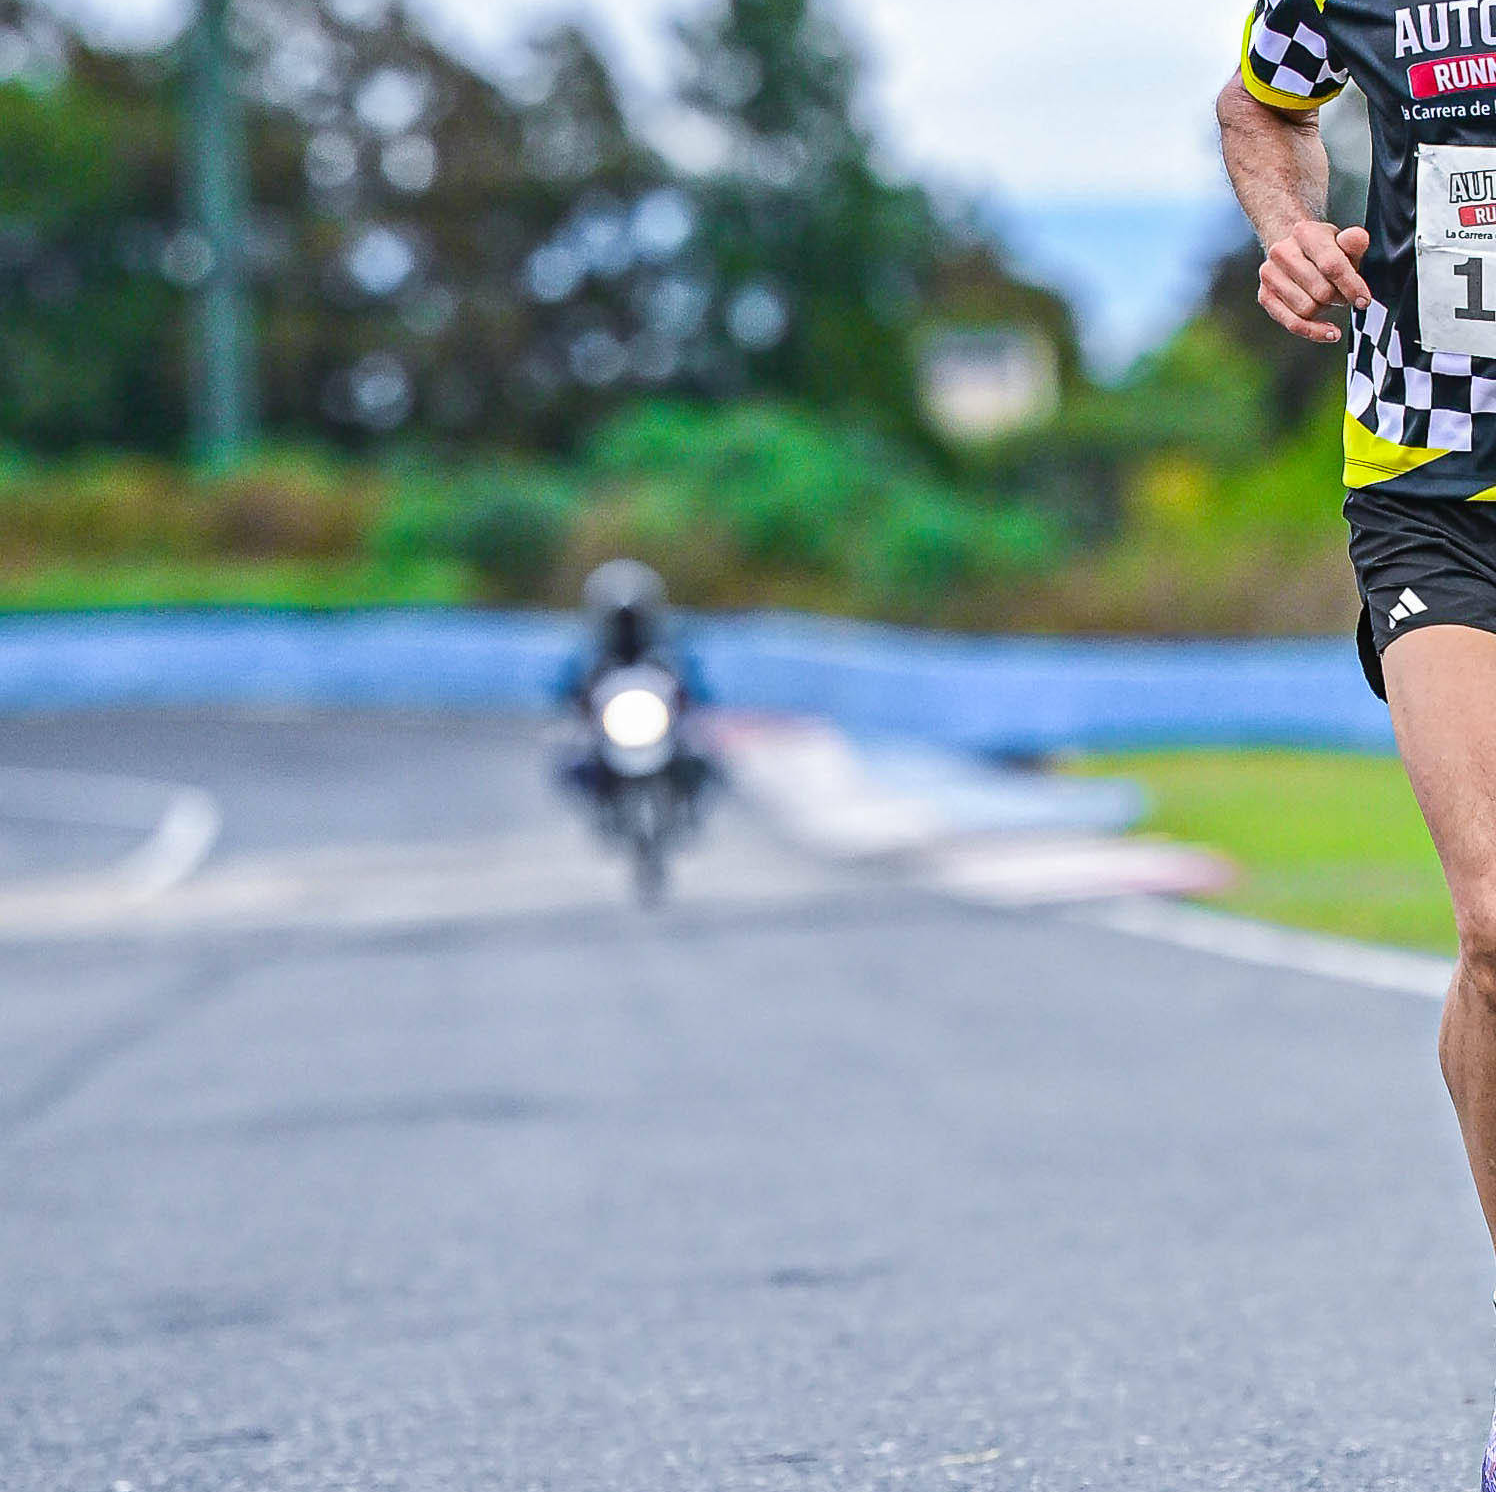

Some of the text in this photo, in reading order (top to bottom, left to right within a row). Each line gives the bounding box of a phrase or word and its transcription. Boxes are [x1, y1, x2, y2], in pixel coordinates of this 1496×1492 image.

[1411, 104, 1467, 120] Carrera
[1470, 100, 1491, 116] de
[1445, 228, 1457, 239] La
[1458, 230, 1493, 240] Carrera
